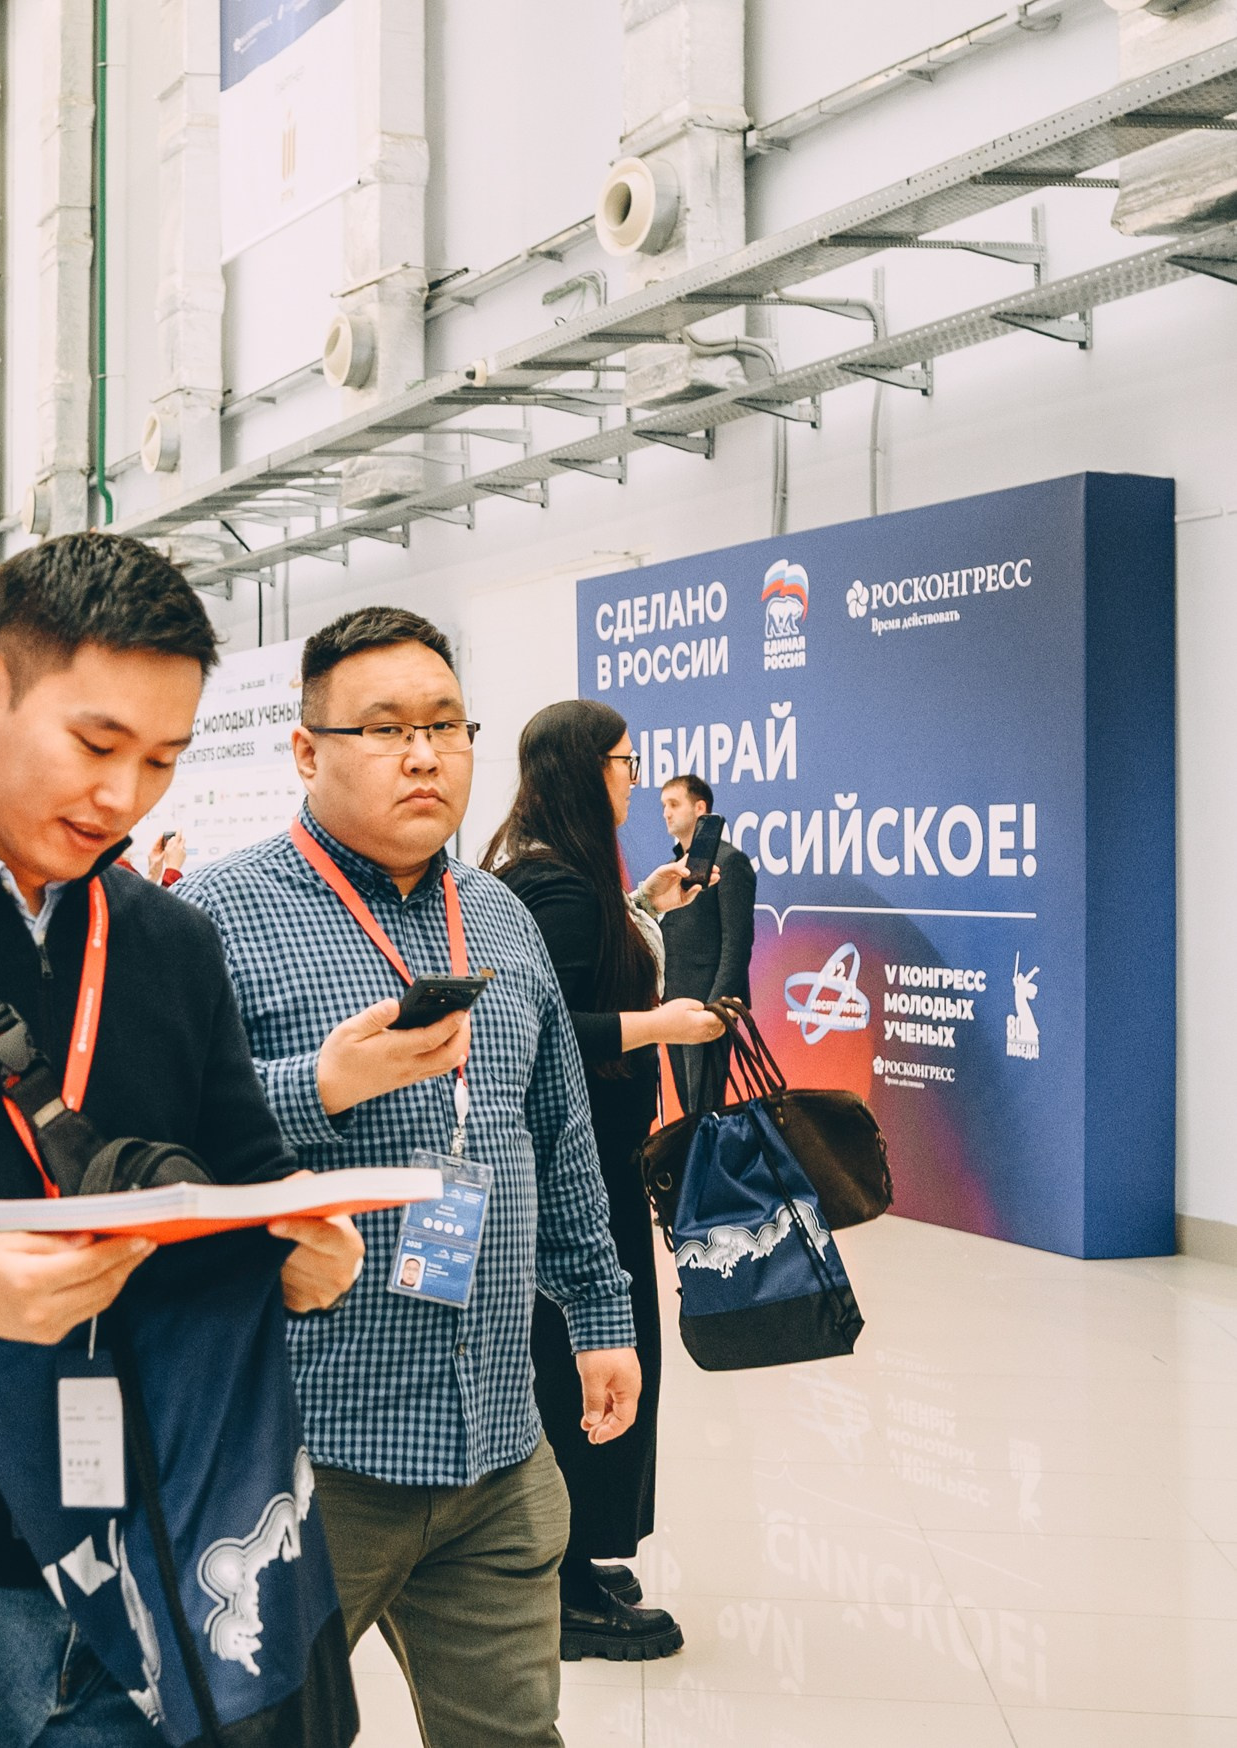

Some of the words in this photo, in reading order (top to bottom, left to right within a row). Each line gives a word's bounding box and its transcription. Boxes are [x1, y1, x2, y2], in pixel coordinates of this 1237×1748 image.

[871, 558, 1032, 609] РОСКОНГРЕСС
[596, 581, 728, 645] СДЕЛАНО
[871, 617, 900, 636] Время
[902, 610, 960, 630] действовать
[764, 636, 805, 655] ЕДИНАЯ
[597, 654, 612, 690] В
[618, 635, 728, 688] РОССИИ
[764, 651, 805, 671] РОССИЯ
[203, 708, 255, 734] МОЛОДЫХ
[217, 742, 256, 760] CONGRESS
[630, 701, 796, 788] БИРАЙ
[712, 793, 1037, 877] ССИЙСКОЕ!
[884, 964, 897, 985] V
[899, 965, 987, 992] КОНГРЕСС
[884, 992, 974, 1021] МОЛОДЫХ
[884, 1020, 955, 1048] УЧЕНЫХ
[885, 1060, 955, 1082] РОСКОНГРЕСС
